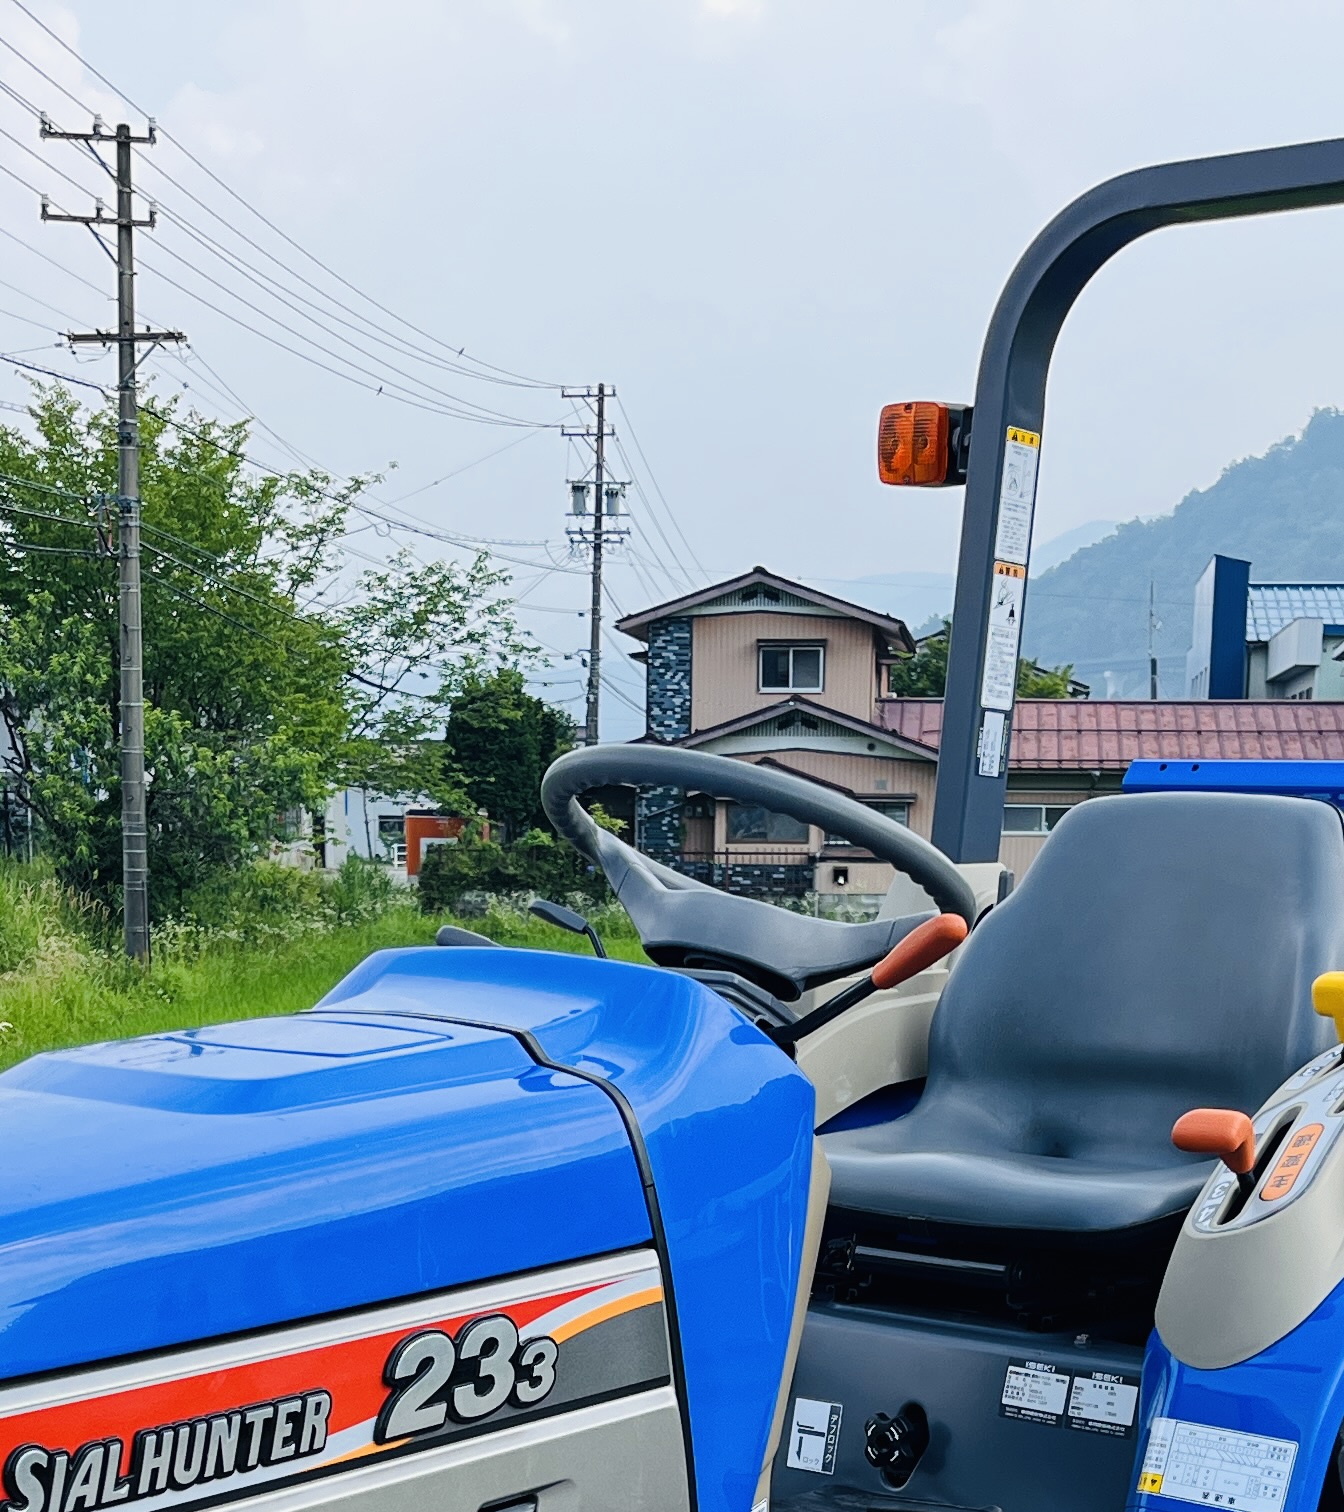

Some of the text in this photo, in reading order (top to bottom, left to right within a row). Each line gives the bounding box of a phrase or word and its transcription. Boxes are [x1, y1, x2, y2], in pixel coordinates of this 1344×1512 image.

[1025, 1361, 1056, 1373] ISEKI
[1091, 1371, 1124, 1384] ISEKI
[135, 1390, 332, 1497] HUNTER
[825, 1414, 839, 1463] デフロック
[802, 1456, 820, 1466] ロック
